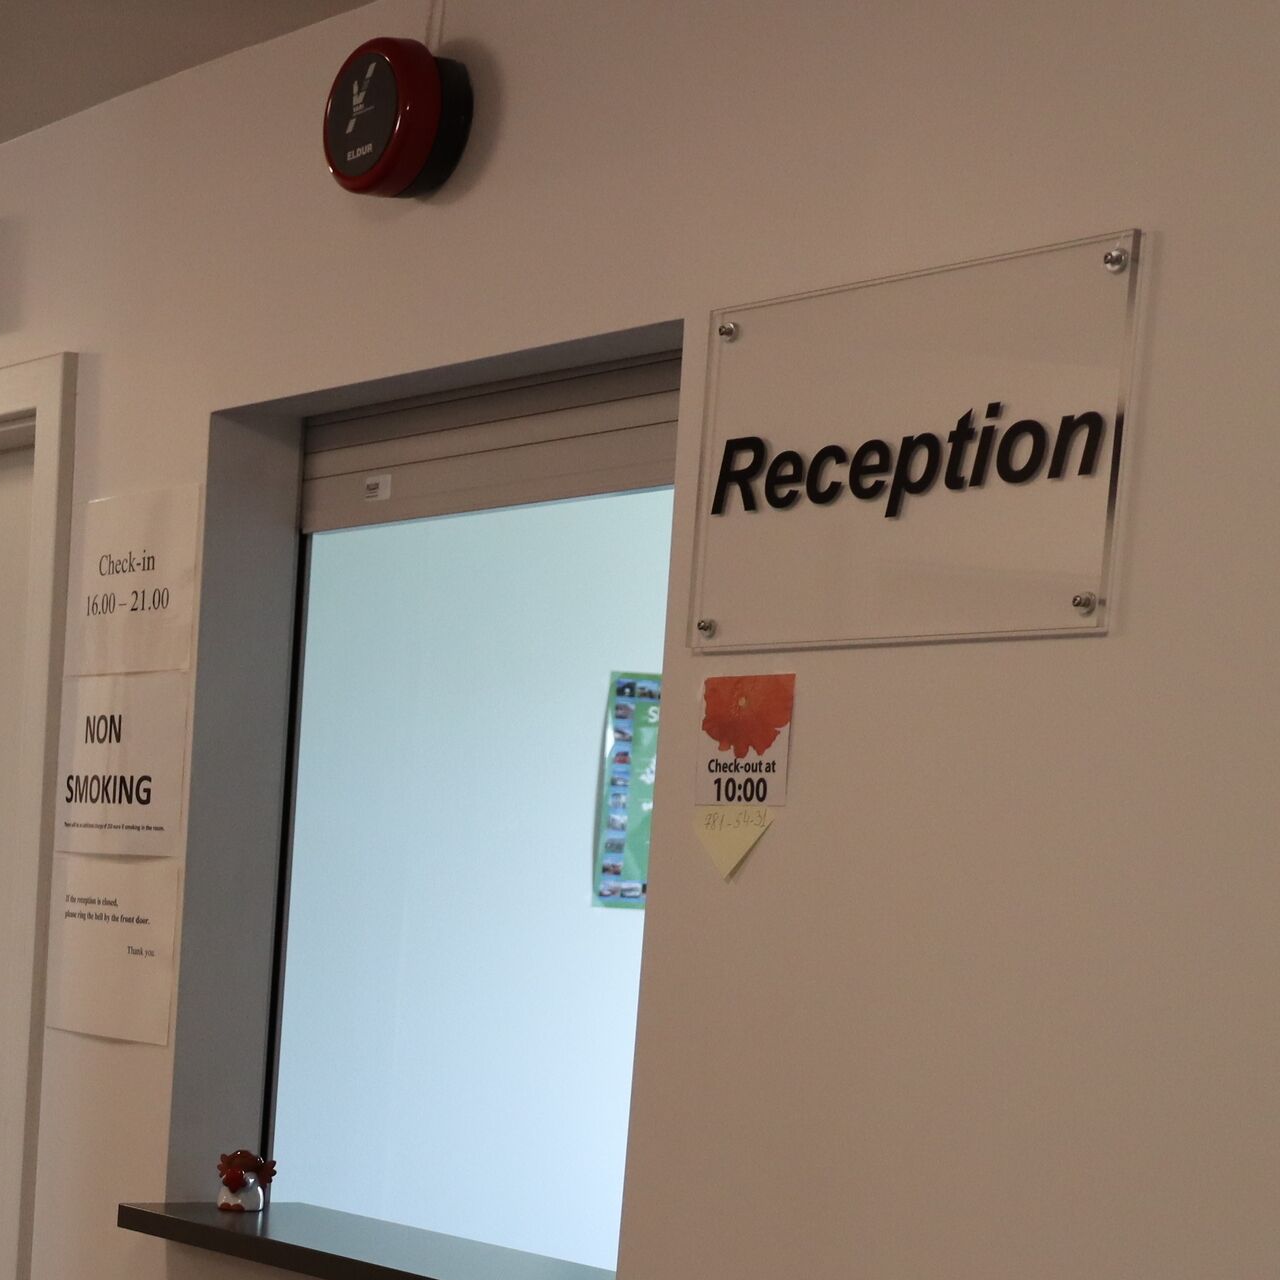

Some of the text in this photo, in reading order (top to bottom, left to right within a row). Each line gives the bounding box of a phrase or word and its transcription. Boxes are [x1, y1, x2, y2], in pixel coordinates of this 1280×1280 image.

[346, 143, 373, 161] ELDUR
[710, 401, 1104, 518] Reception
[98, 550, 156, 577] Check-in
[86, 592, 116, 616] 16.00
[130, 587, 170, 612] 21.00
[85, 714, 122, 744] NON
[708, 758, 776, 773] Check-out at
[65, 774, 152, 805] SMOKING
[713, 777, 767, 802] 10:00
[111, 913, 119, 923] the
[120, 914, 135, 924] front
[127, 945, 143, 956] Thank
